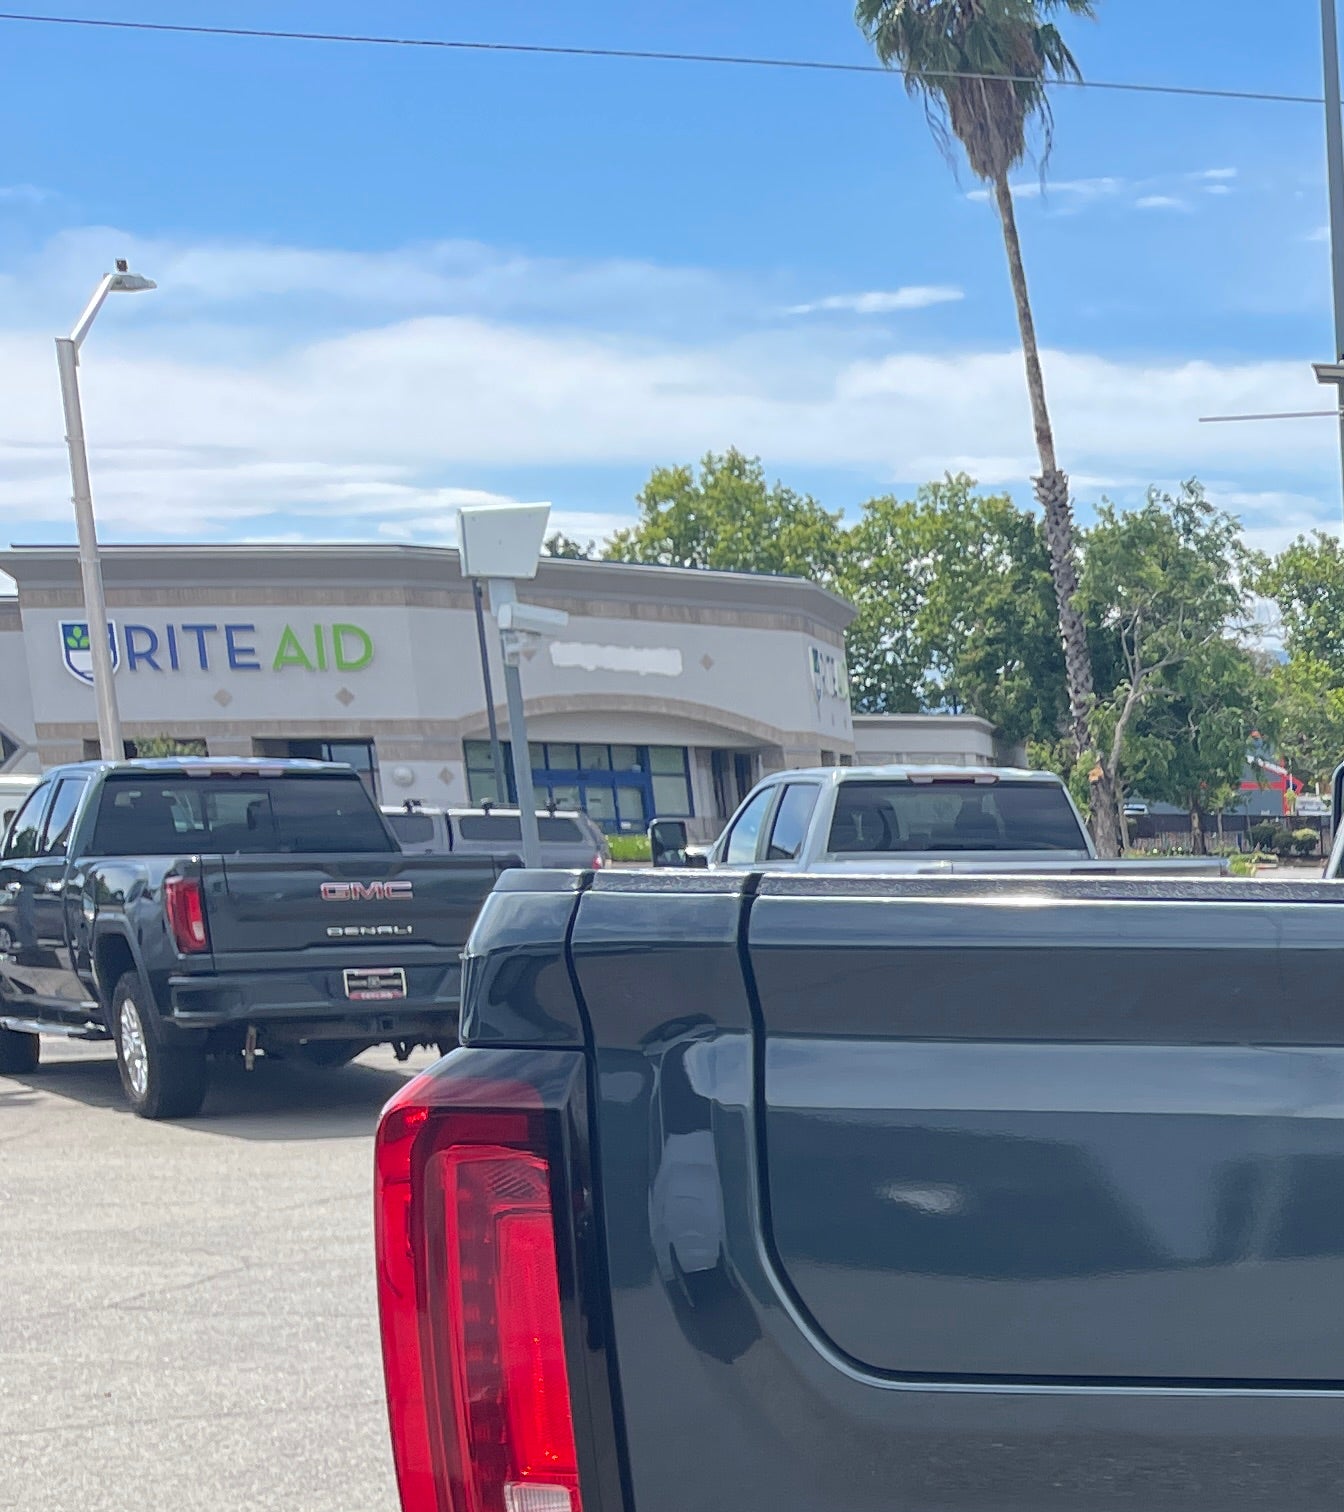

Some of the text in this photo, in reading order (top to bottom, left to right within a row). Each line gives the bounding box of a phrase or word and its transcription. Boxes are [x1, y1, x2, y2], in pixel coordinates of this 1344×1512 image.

[124, 623, 374, 672] RITE AID
[320, 881, 413, 900] GMC
